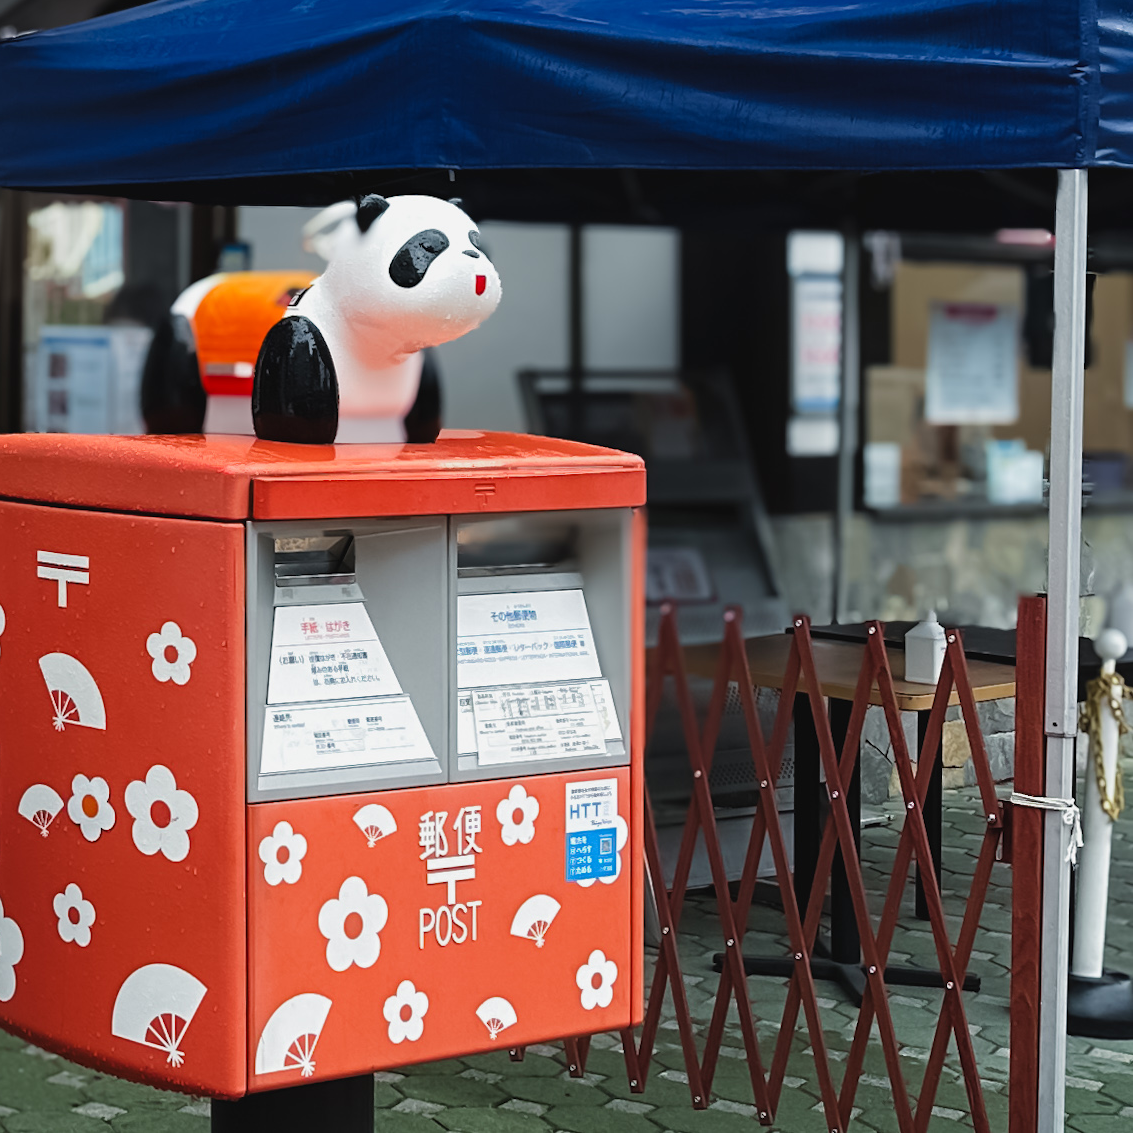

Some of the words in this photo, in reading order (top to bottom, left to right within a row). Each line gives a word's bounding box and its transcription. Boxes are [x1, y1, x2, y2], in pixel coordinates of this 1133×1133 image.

[418, 805, 483, 860] 郵便
[570, 801, 602, 819] HTT
[419, 900, 482, 950] POST
